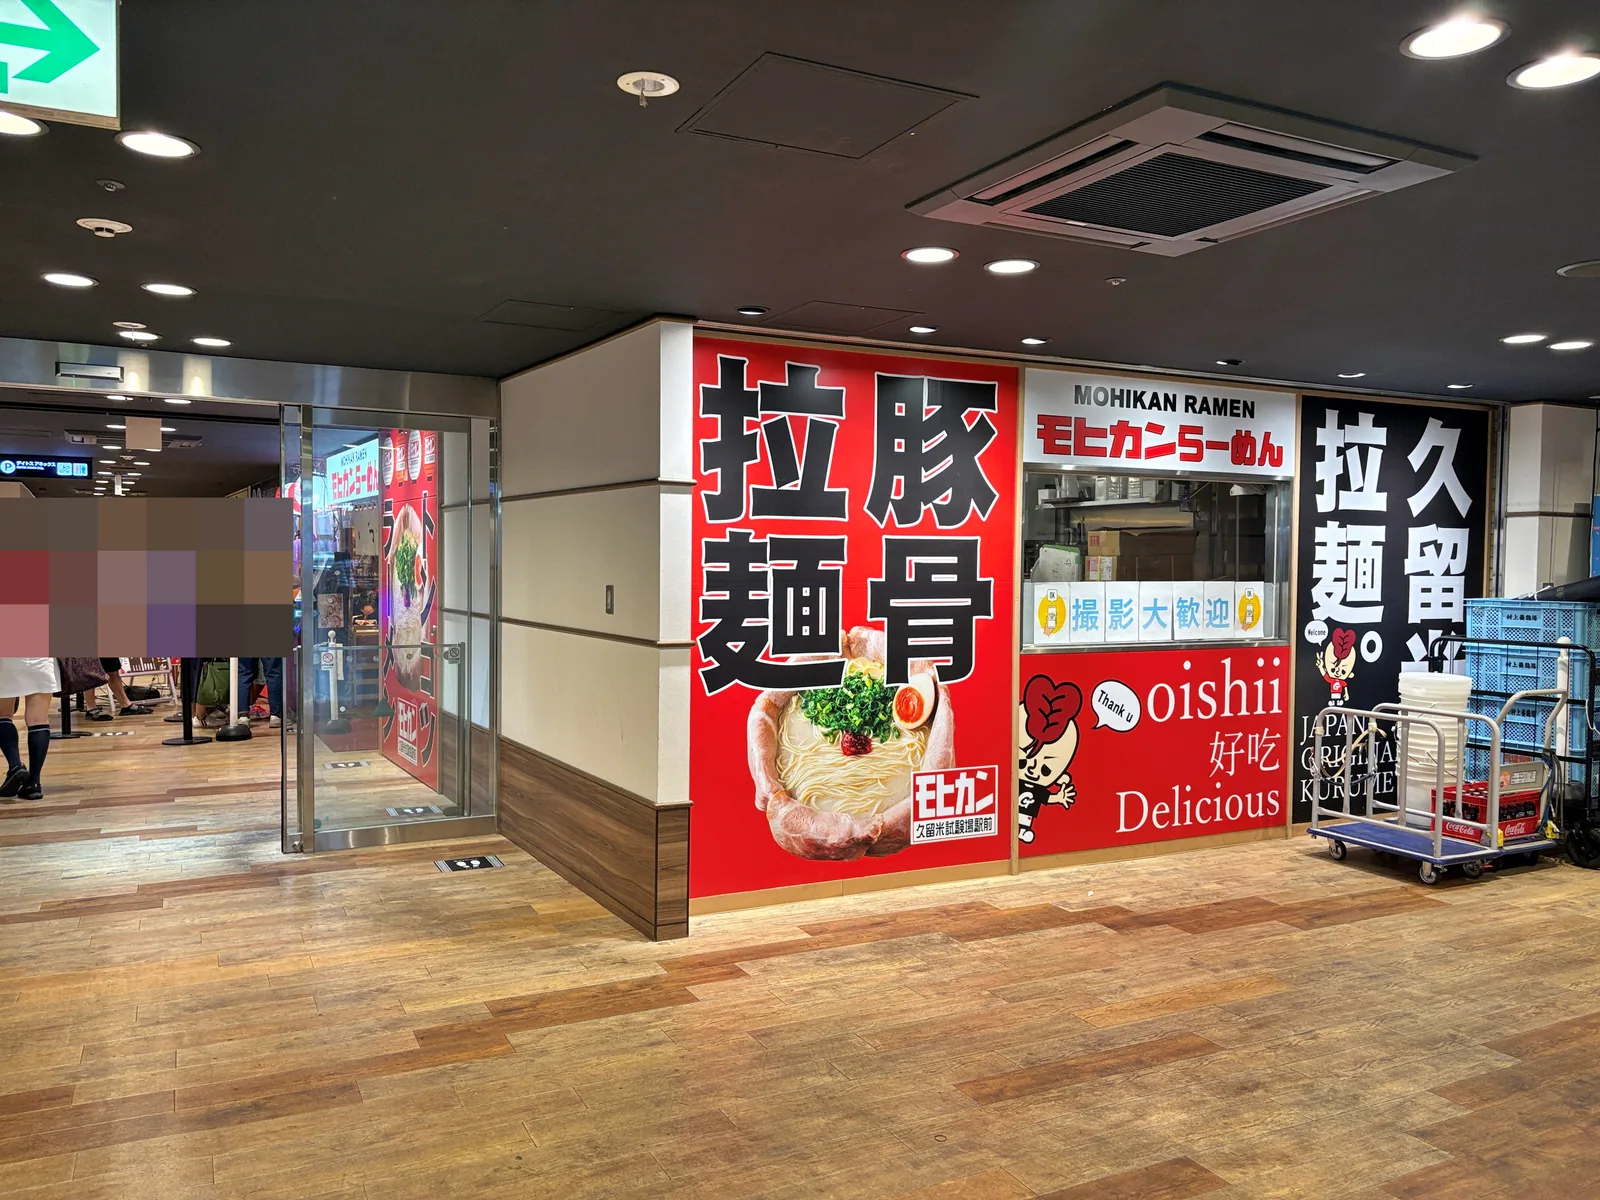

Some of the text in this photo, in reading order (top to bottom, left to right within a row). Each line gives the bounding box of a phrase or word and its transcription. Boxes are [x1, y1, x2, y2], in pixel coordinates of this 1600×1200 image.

[1074, 384, 1255, 419] MOHIKAN RAMEN
[1037, 413, 1284, 468] モヒカンらーめん
[696, 353, 849, 696] 拉麺
[863, 371, 999, 686] 豚骨
[1072, 597, 1230, 632] 撮影大歓迎
[1097, 689, 1134, 724] Thank u
[1147, 656, 1282, 723] oishii
[1209, 726, 1282, 778] 好吃
[915, 770, 994, 819] モヒカン
[1116, 781, 1280, 834] Delicious
[916, 817, 993, 839] 久留米試験場駅前
